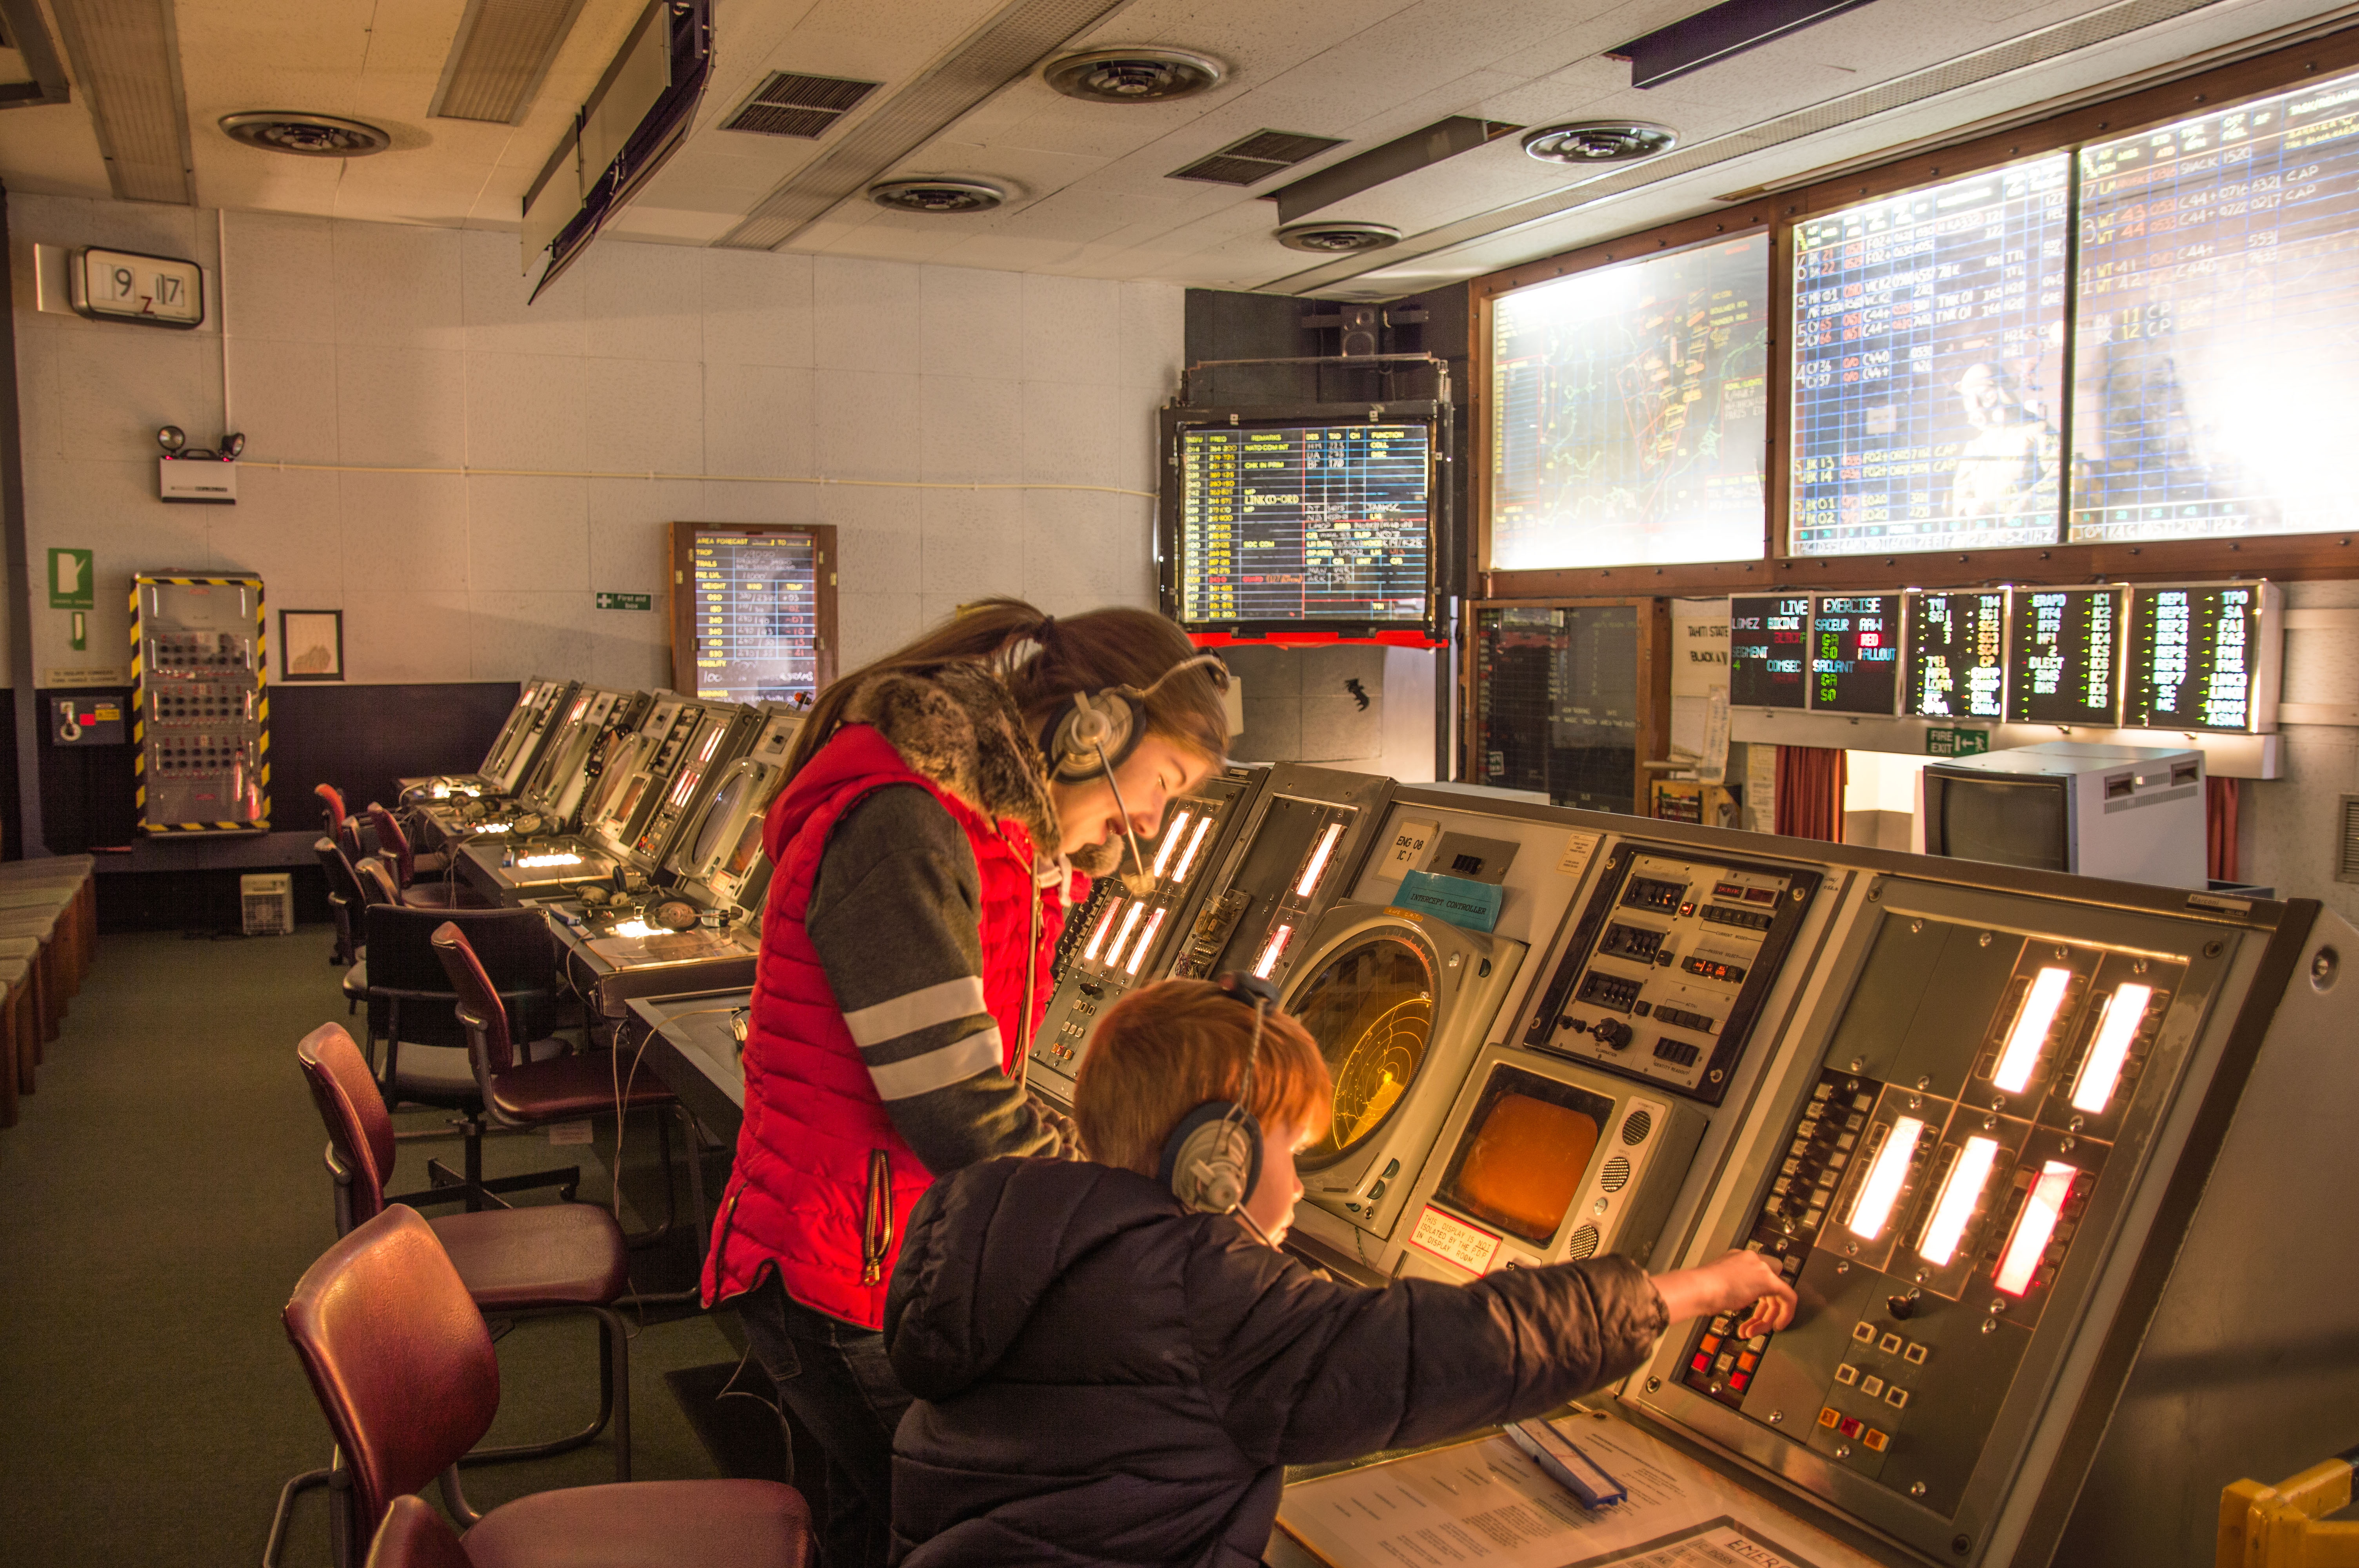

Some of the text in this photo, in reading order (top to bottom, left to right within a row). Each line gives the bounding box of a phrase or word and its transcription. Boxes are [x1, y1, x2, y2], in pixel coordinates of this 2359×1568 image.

[2286, 165, 2319, 181] CAP
[2285, 184, 2316, 200] CAP
[114, 268, 132, 297] 9
[1329, 459, 1344, 468] 170
[2157, 592, 2187, 605] REP1
[1781, 600, 1808, 615] LIVE
[1823, 598, 1881, 613] EXERCISE
[2223, 605, 2244, 619] SA
[2038, 607, 2061, 619] IFF4
[2157, 606, 2190, 619] REP2
[1767, 617, 1800, 630] BIKINI
[1815, 618, 1882, 631] SACEUR AAW
[1943, 621, 1952, 632] 2
[1978, 620, 1999, 632] SC2
[2037, 619, 2060, 632] IFF5
[2156, 619, 2189, 632] REP3
[2217, 619, 2244, 632] FA1
[1710, 626, 1728, 637] STATE
[1944, 632, 1951, 644] 3
[1978, 632, 1999, 644] SC3
[2036, 632, 2057, 644] HF1
[2155, 632, 2188, 645] REP4
[2216, 632, 2246, 645] FA2
[1732, 646, 1768, 658] SEGMENT
[1977, 644, 1999, 655] SC4
[2048, 645, 2057, 657] 2
[2154, 646, 2187, 659] REP5
[1690, 651, 1715, 662] BLACK
[1767, 659, 1801, 672] COMSEC
[1813, 659, 1855, 673] SACLANT
[2154, 659, 2186, 671] REP6
[2152, 671, 2186, 685] REP7
[1931, 730, 1953, 742] FIRE
[1930, 742, 1952, 754] EXIT
[1396, 836, 1424, 850] ENG 08
[1397, 850, 1412, 861] IC 1
[1410, 894, 1487, 915] INTERCEPT CONTROLLER
[2190, 897, 2219, 906] Marconi
[1596, 1047, 1617, 1057] ILLUMINATION
[1671, 1067, 1689, 1075] READOUT
[1421, 1223, 1447, 1240] ISOLATED
[1449, 1236, 1456, 1245] BY
[1458, 1241, 1470, 1251] THE
[1425, 1214, 1436, 1225] THIS
[1442, 1223, 1466, 1239] DISPLAY
[1477, 1240, 1491, 1251] NOT
[1428, 1237, 1450, 1252] DISPLAY
